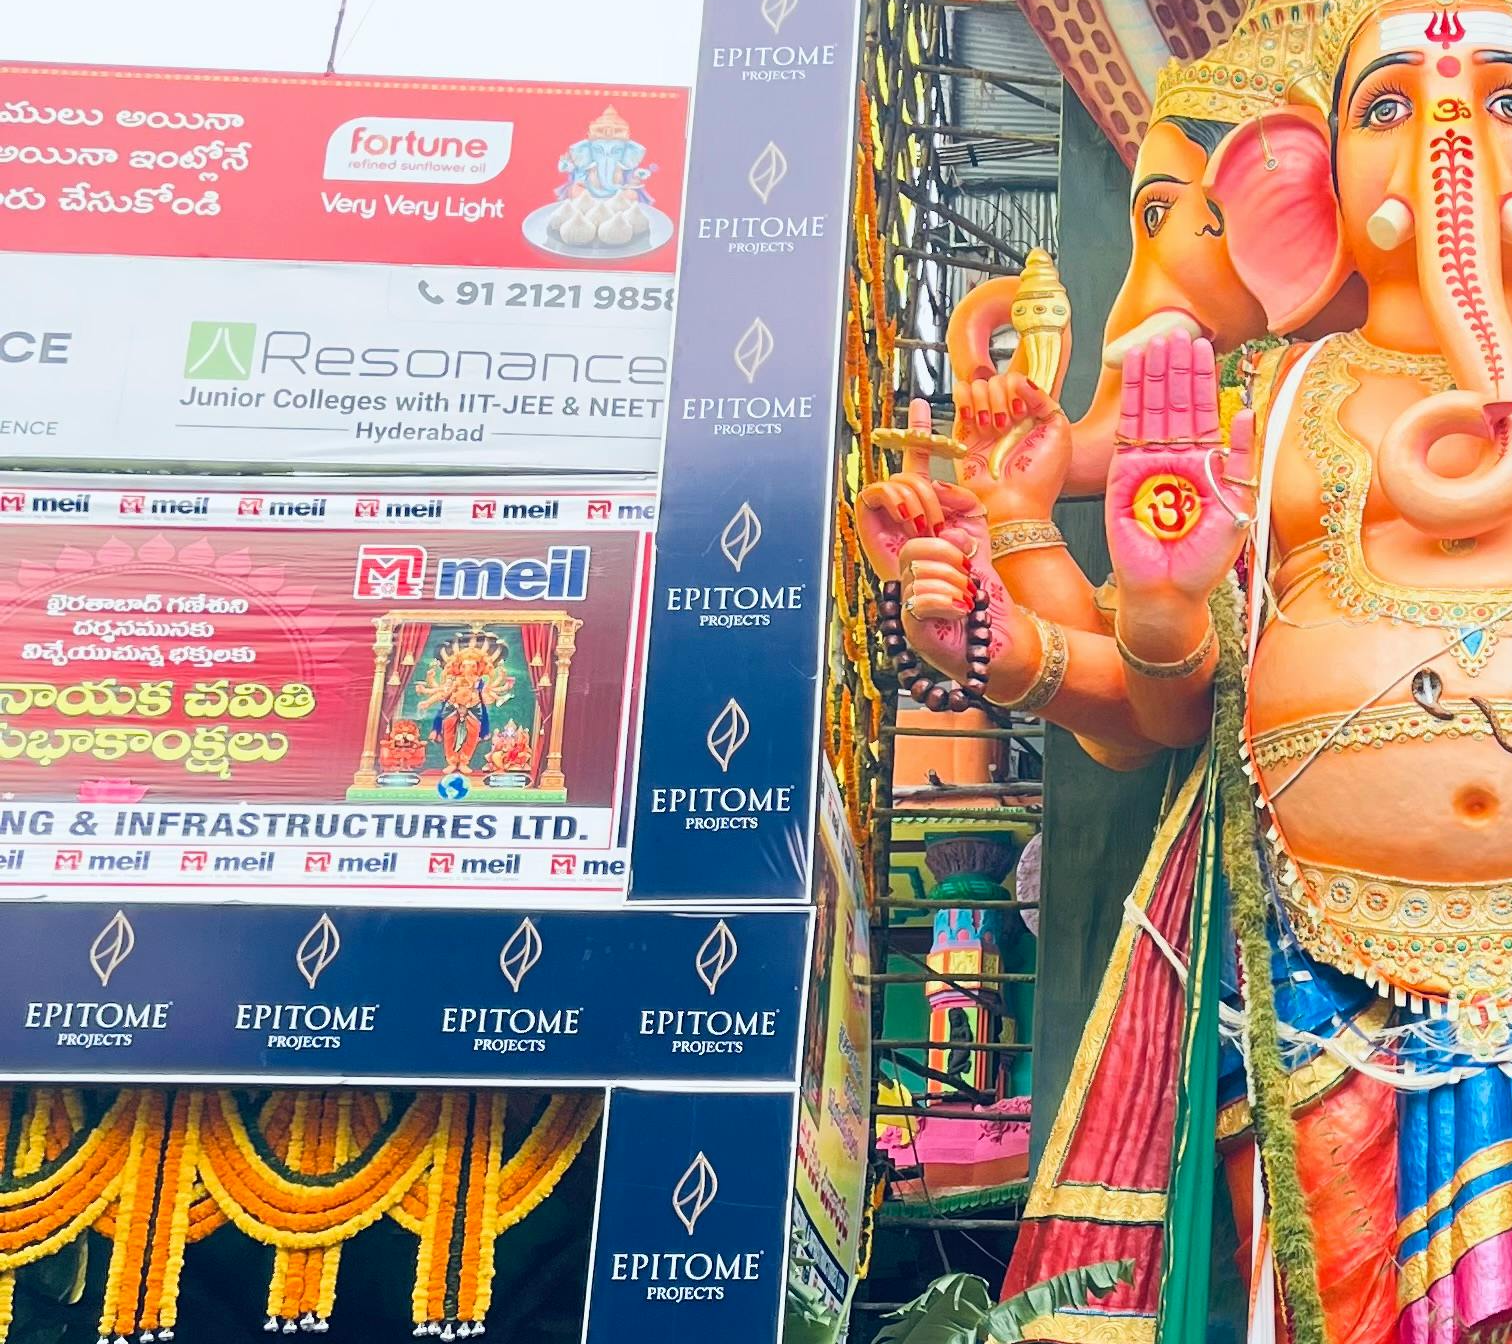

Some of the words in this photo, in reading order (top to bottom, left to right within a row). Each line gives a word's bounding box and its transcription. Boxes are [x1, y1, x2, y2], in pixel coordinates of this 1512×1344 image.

[713, 46, 834, 67] EPITOME
[743, 70, 805, 82] PROJECTS
[351, 127, 488, 159] fortune
[348, 159, 396, 171] refined
[400, 160, 466, 174] sunflower
[470, 163, 487, 174] oil
[321, 192, 376, 220] Very
[384, 194, 439, 221] Very
[446, 198, 504, 222] Light
[456, 281, 494, 306] 91
[505, 282, 580, 309] 2121
[261, 330, 666, 385] Resonance
[180, 386, 265, 407] Junior
[273, 388, 386, 415] Colleges
[395, 391, 449, 413] with
[459, 393, 554, 415] IIT-JEE
[562, 396, 579, 416] &
[590, 397, 664, 418] NEET
[683, 397, 811, 419] EPITOME
[355, 421, 484, 443] Hyderabad
[715, 424, 781, 436] PROJECTS
[32, 494, 90, 513] meil
[269, 498, 327, 517] meil
[503, 500, 559, 519] meil
[438, 547, 588, 598] meil
[183, 680, 316, 719] చవితి
[652, 788, 790, 812] EPITOME
[68, 810, 98, 836] &
[115, 810, 497, 840] INFRASTRUCTURES
[511, 814, 589, 841] LTD.
[686, 817, 758, 831] PROJECTS
[89, 850, 151, 871] meil
[338, 852, 398, 873] meil
[25, 1003, 169, 1028] EPITOME
[58, 1034, 132, 1048] PROJECTS
